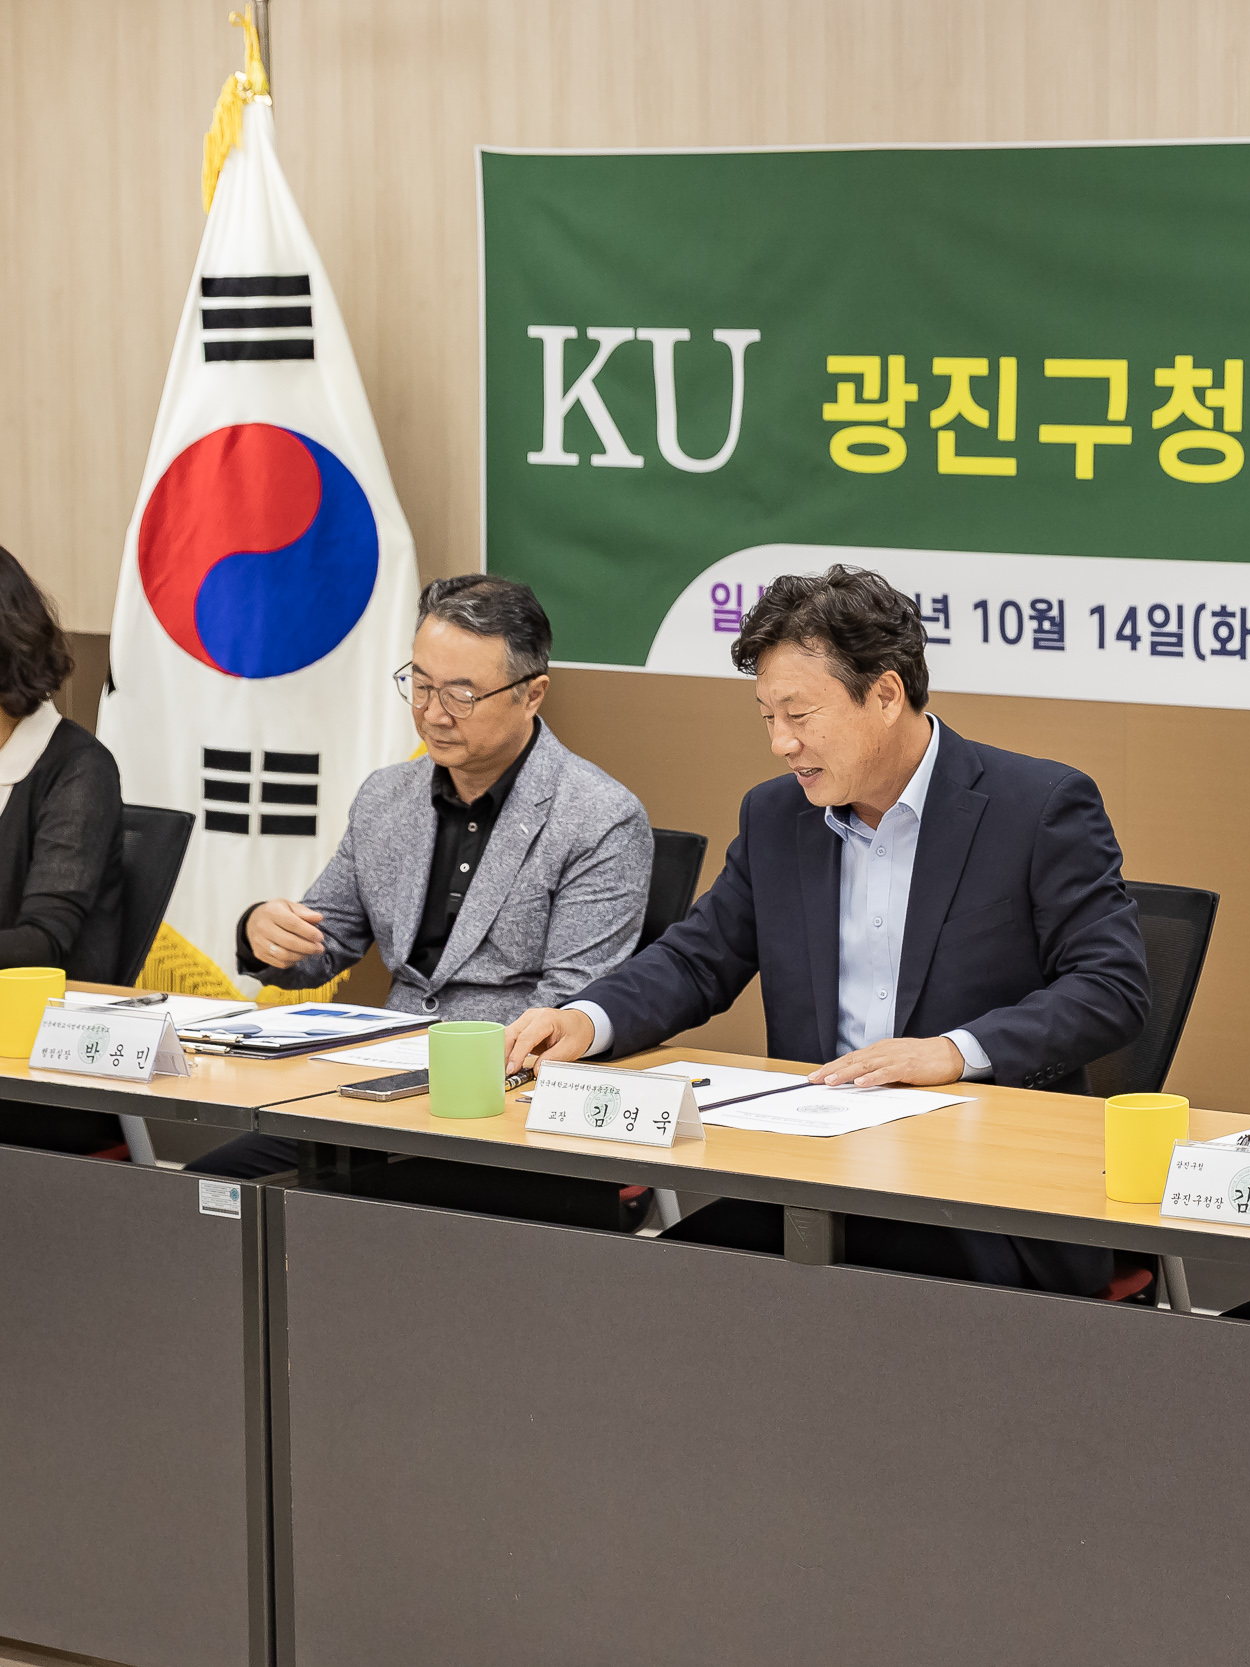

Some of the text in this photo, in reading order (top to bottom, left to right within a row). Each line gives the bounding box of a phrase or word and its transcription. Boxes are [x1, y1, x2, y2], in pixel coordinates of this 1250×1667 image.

[527, 324, 761, 473] KU
[710, 582, 765, 633] 일
[972, 598, 1066, 652] 10월
[548, 1111, 567, 1122] 교장
[1171, 1192, 1224, 1210] 광진구청장
